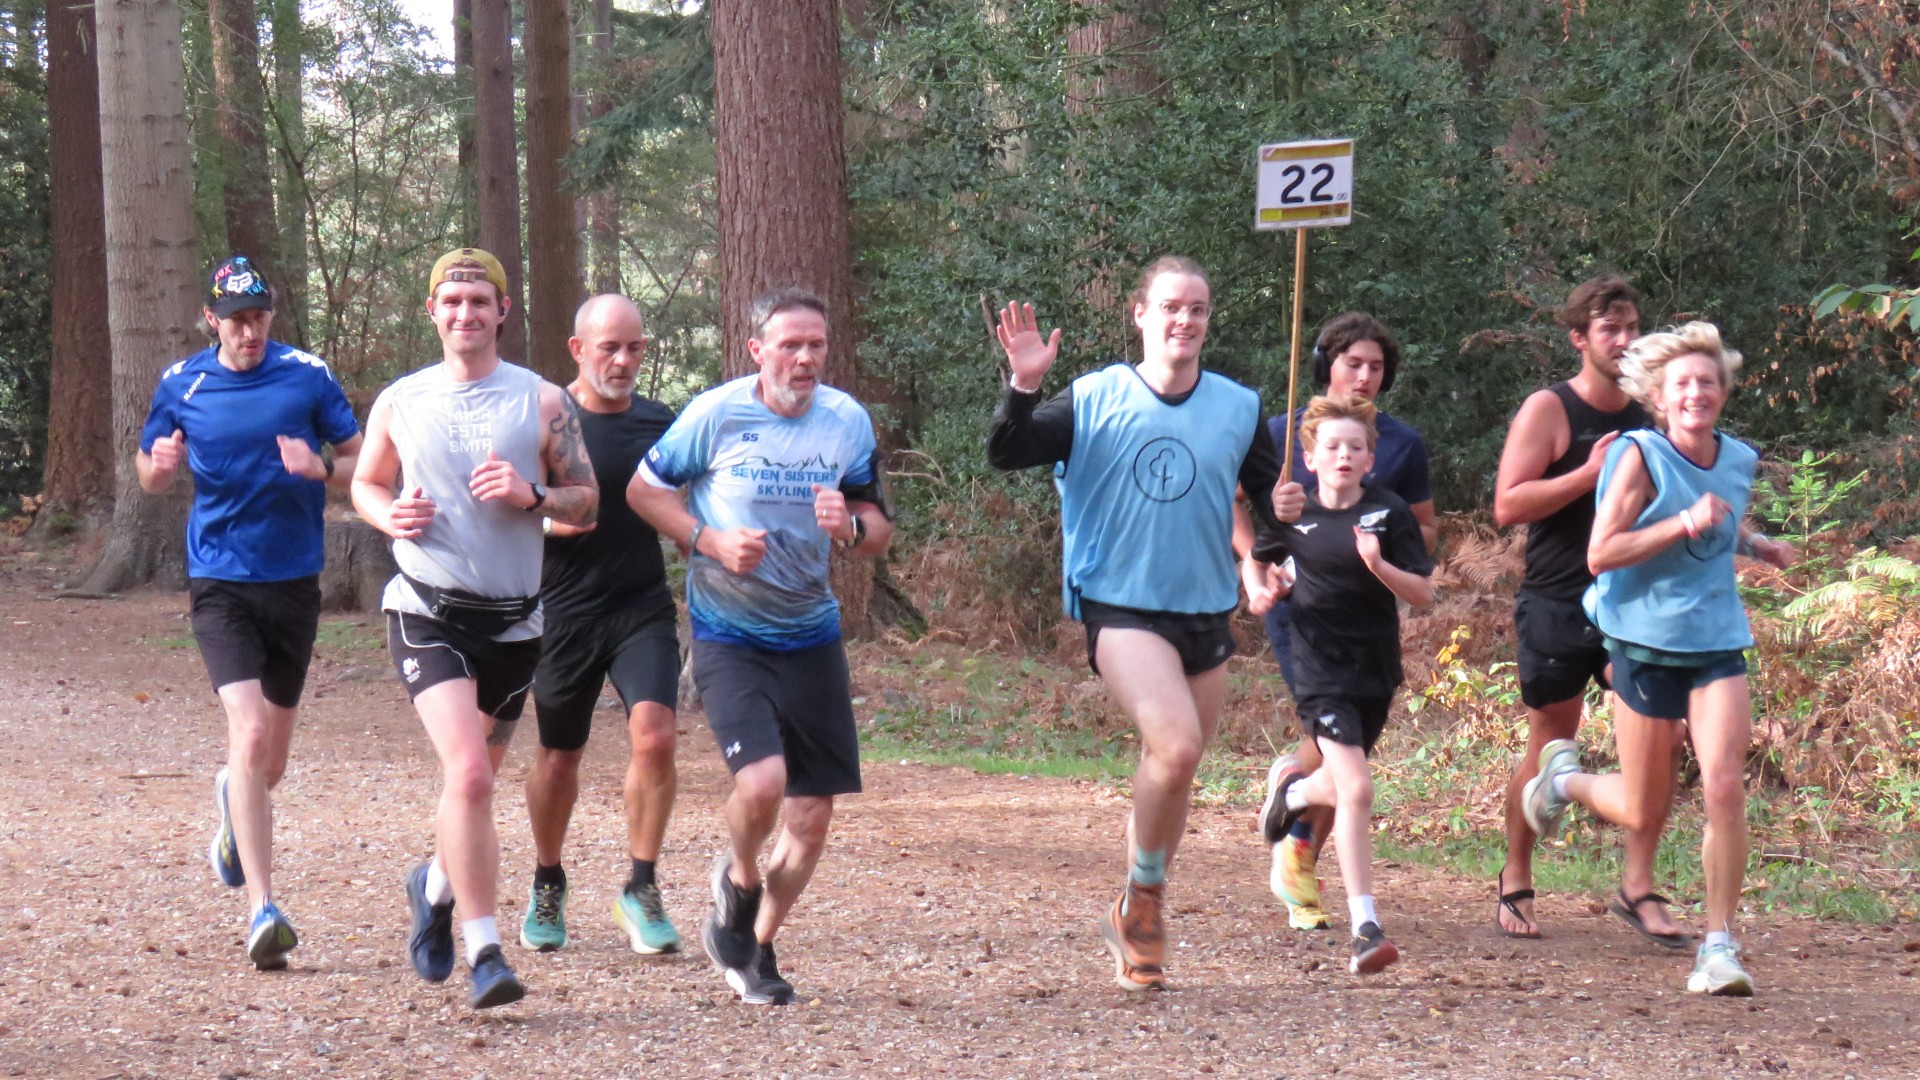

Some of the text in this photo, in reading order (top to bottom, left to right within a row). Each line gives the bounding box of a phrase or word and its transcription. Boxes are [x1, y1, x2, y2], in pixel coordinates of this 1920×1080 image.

[1281, 163, 1334, 204] 22
[183, 372, 206, 400] Kappa
[448, 423, 492, 438] FSTR
[742, 433, 759, 442] SS
[449, 439, 492, 453] SMTR
[731, 465, 837, 483] SEVEN SISTERS
[757, 484, 813, 498] SKYLINE
